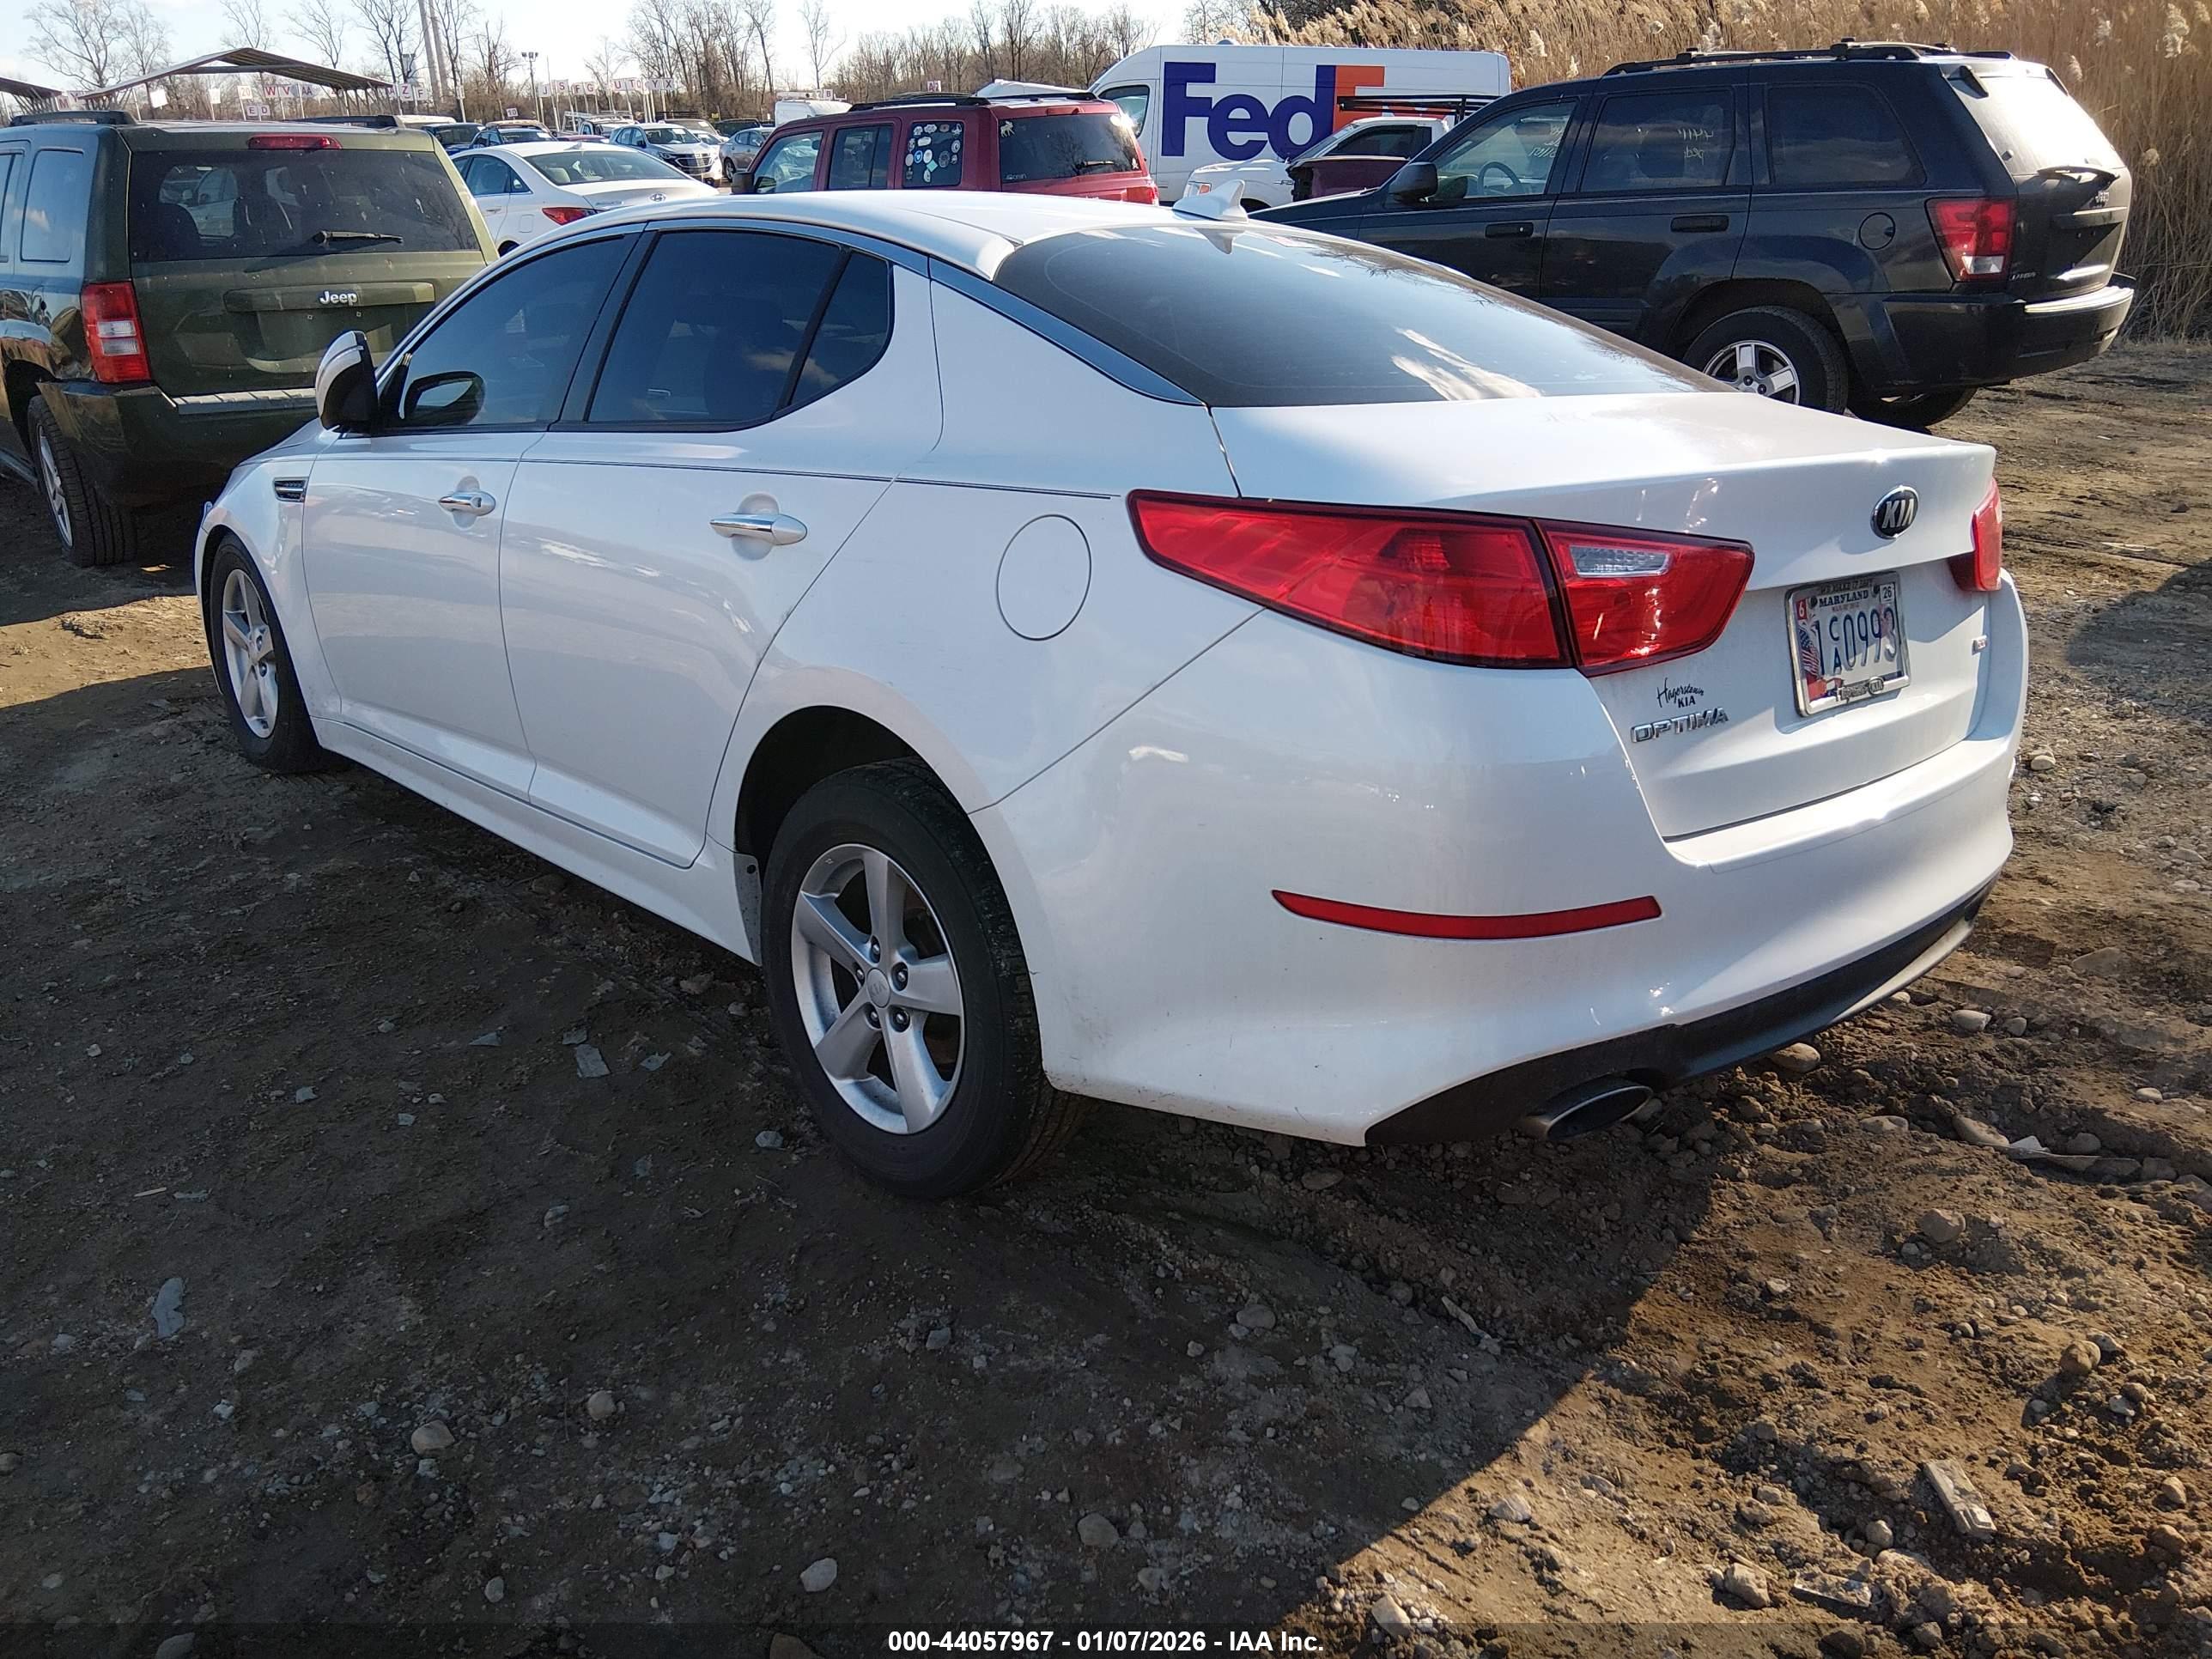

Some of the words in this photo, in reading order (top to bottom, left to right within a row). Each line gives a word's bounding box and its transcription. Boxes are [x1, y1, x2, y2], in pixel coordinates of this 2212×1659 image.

[264, 87, 276, 95] W
[283, 86, 290, 95] V
[402, 86, 410, 94] Z
[614, 80, 622, 89] U
[1161, 62, 1453, 161] FedE
[319, 290, 357, 307] Jeep
[1881, 498, 1915, 529] KIA
[1819, 589, 1869, 608] MARYLAND
[1883, 586, 1892, 599] 26
[1798, 602, 1804, 617] 6
[1677, 695, 1696, 708] KIA
[1630, 707, 1729, 743] OPTIMA
